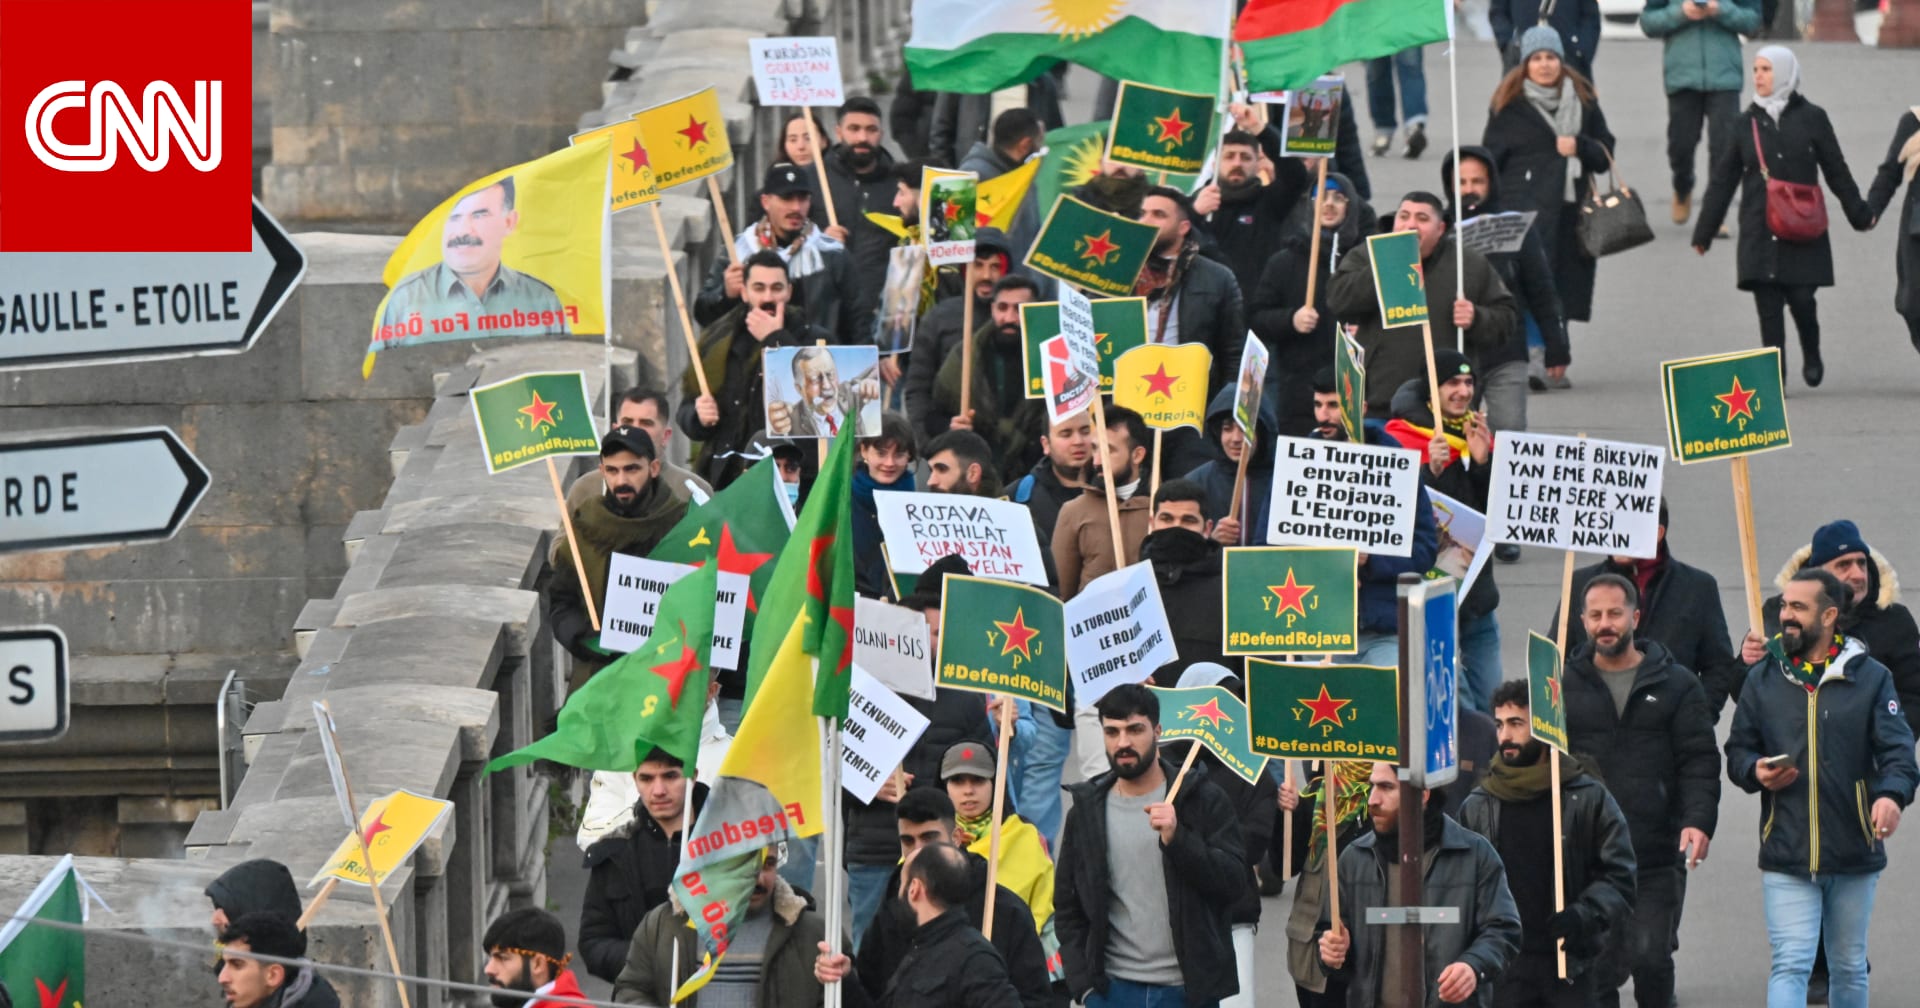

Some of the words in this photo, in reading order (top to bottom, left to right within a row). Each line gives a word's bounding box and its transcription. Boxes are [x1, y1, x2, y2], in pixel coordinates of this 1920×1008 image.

[1408, 274, 1416, 286] Y
[133, 281, 241, 326] ETOILE
[515, 417, 525, 430] Y
[541, 425, 550, 437] P
[1711, 405, 1722, 418] Y
[1738, 418, 1747, 431] P
[1755, 398, 1761, 412] J
[494, 438, 596, 465] #DefendRojava
[1511, 440, 1545, 457] YAN
[1684, 429, 1787, 455] #DefendRojava
[1288, 442, 1315, 460] La
[1323, 446, 1410, 470] Turquie
[1303, 466, 1392, 487] envahit
[1509, 461, 1545, 478] YAN
[1286, 481, 1308, 497] le
[1316, 483, 1402, 508] Rojava.
[1538, 485, 1562, 503] EM
[1615, 492, 1655, 513] XWE
[906, 503, 994, 524] ROJAVA
[1291, 500, 1395, 527] L'Europe
[1530, 505, 1560, 524] BER
[911, 523, 1007, 545] ROJHILAT
[1278, 521, 1403, 547] contemple
[1506, 525, 1558, 543] XWAR
[618, 573, 632, 588] LA
[643, 602, 655, 615] LE
[1071, 623, 1083, 638] LA
[1083, 605, 1130, 632] TURQUIE
[1262, 596, 1272, 611] Y
[1286, 614, 1297, 628] P
[1310, 595, 1319, 610] J
[986, 631, 999, 646] Y
[1013, 654, 1023, 669] P
[1035, 641, 1042, 656] J
[1099, 635, 1112, 651] LE
[1229, 632, 1352, 648] #DefendRojava
[943, 663, 1063, 702] #DefendRojava
[1081, 655, 1128, 684] L'EUROPE
[8, 665, 35, 705] S
[862, 701, 908, 740] ENVAHIT
[1291, 707, 1304, 721] Y
[1321, 724, 1333, 738] P
[1348, 708, 1358, 721] J
[1255, 735, 1397, 756] #DefendRojava
